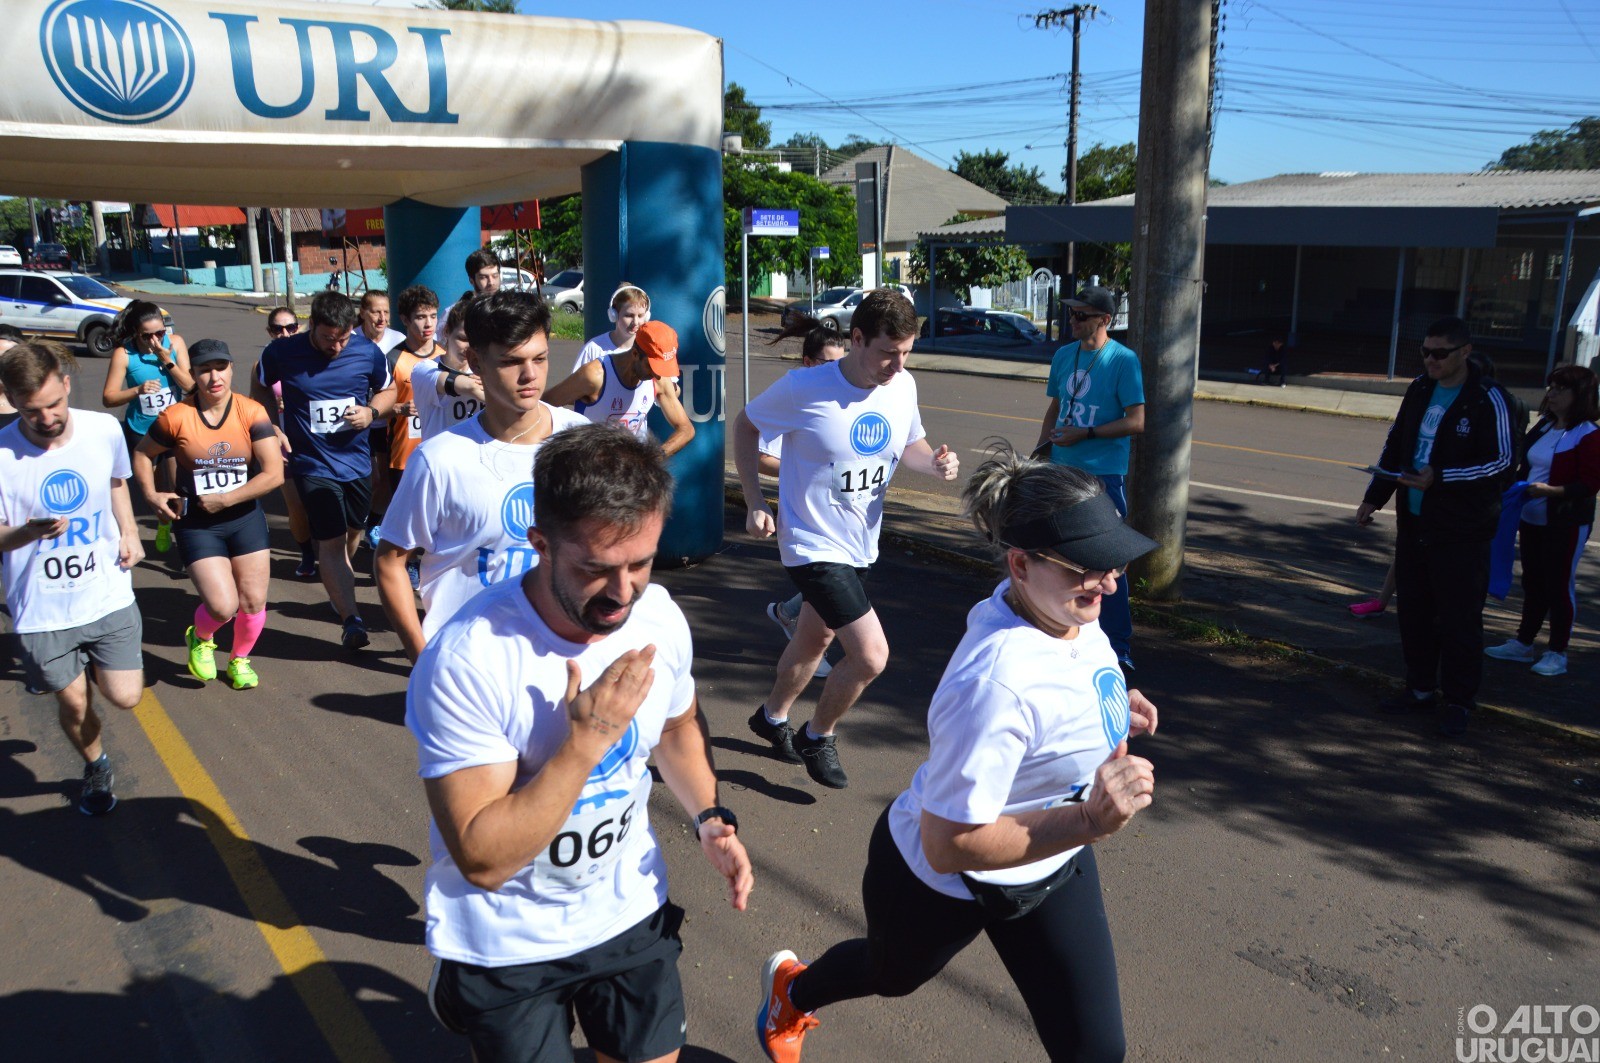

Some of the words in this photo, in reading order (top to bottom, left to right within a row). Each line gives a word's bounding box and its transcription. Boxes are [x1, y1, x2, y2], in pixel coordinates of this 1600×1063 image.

[207, 12, 460, 125] URI
[145, 391, 174, 409] 137
[201, 469, 242, 490] 101
[840, 465, 884, 493] 114
[44, 550, 96, 580] 064
[549, 799, 636, 868] 068
